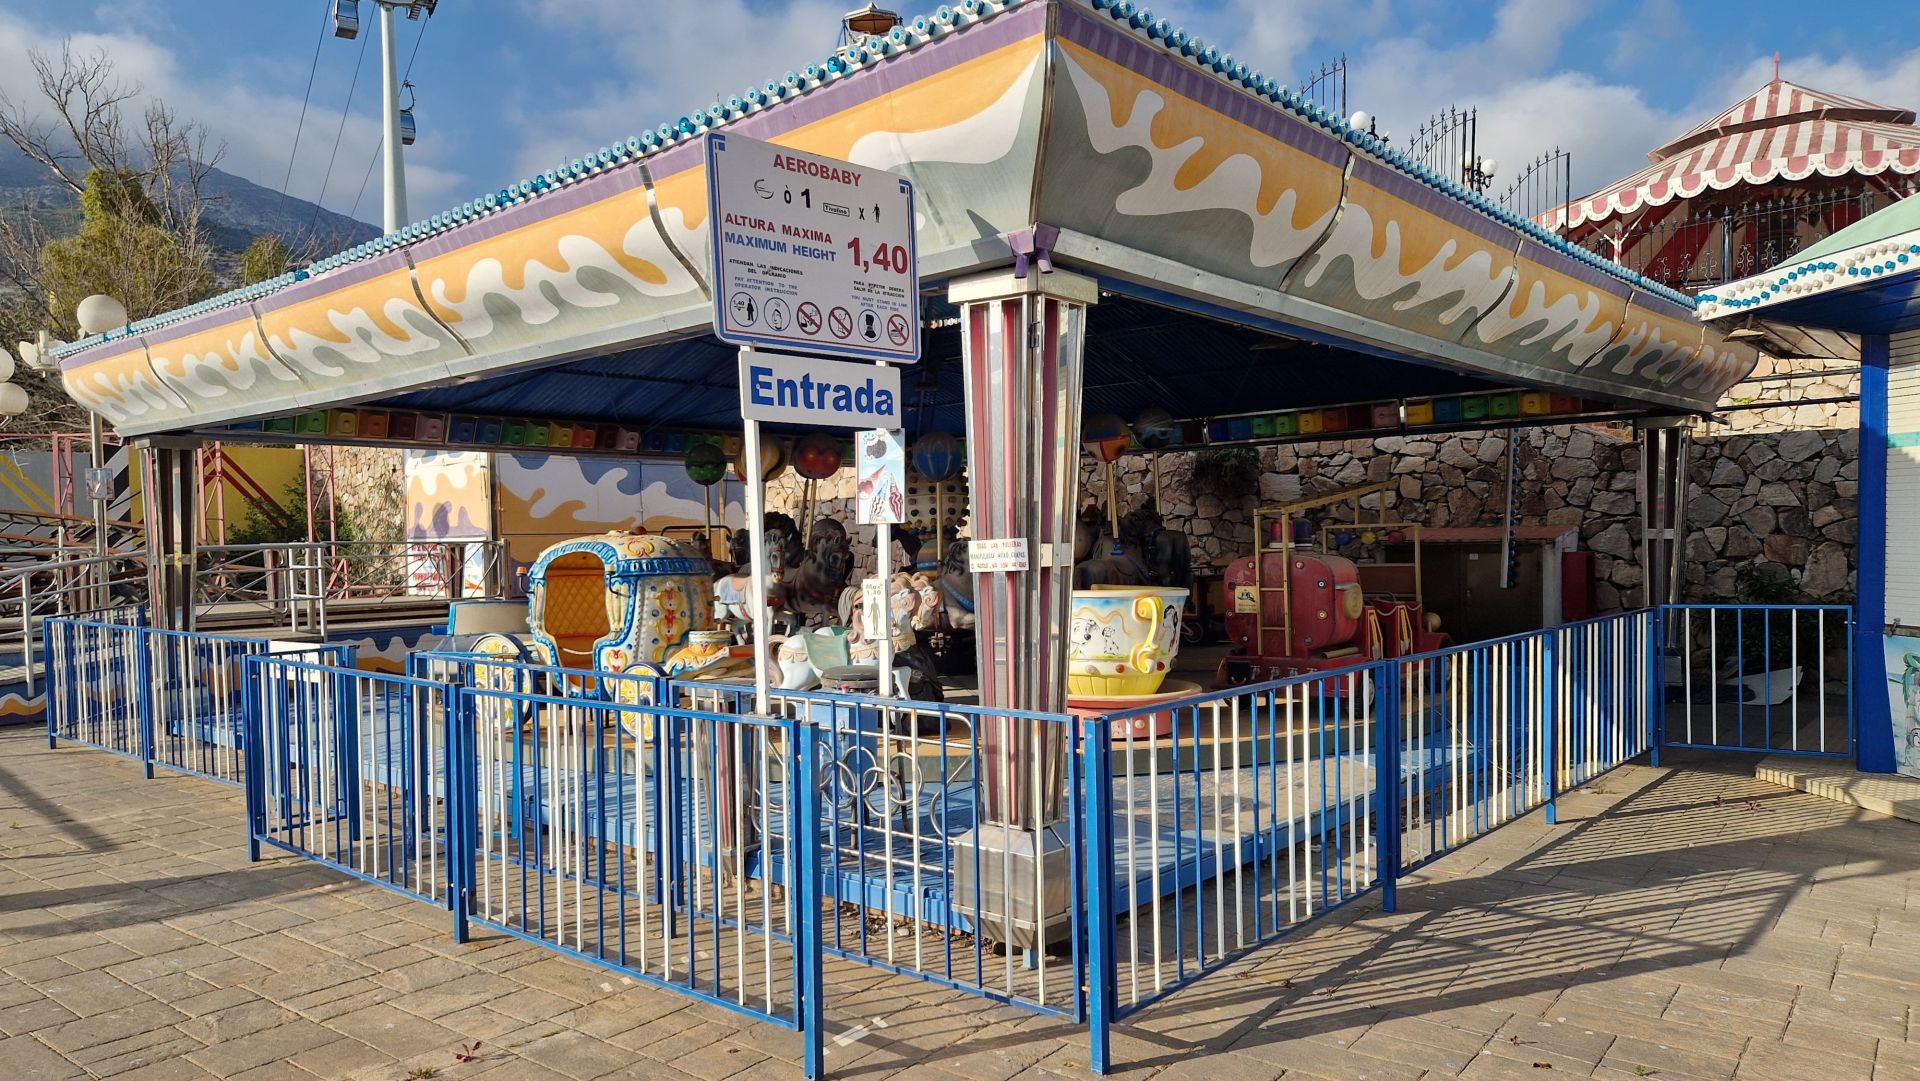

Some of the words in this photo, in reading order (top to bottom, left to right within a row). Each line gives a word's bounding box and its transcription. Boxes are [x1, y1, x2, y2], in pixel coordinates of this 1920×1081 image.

[773, 154, 862, 187] AEROBABY
[801, 188, 811, 208] 1
[824, 205, 848, 215] Tivolino
[725, 213, 776, 233] ALTURA
[782, 224, 833, 244] MAXIMA
[725, 232, 787, 253] MAXIMUM
[793, 244, 837, 262] HEIGHT
[847, 237, 908, 274] 1,40
[729, 258, 754, 267] ATIENDAN
[770, 265, 803, 276] INDICACIONES
[762, 270, 787, 279] OPERARIO
[750, 365, 895, 416] Entrada
